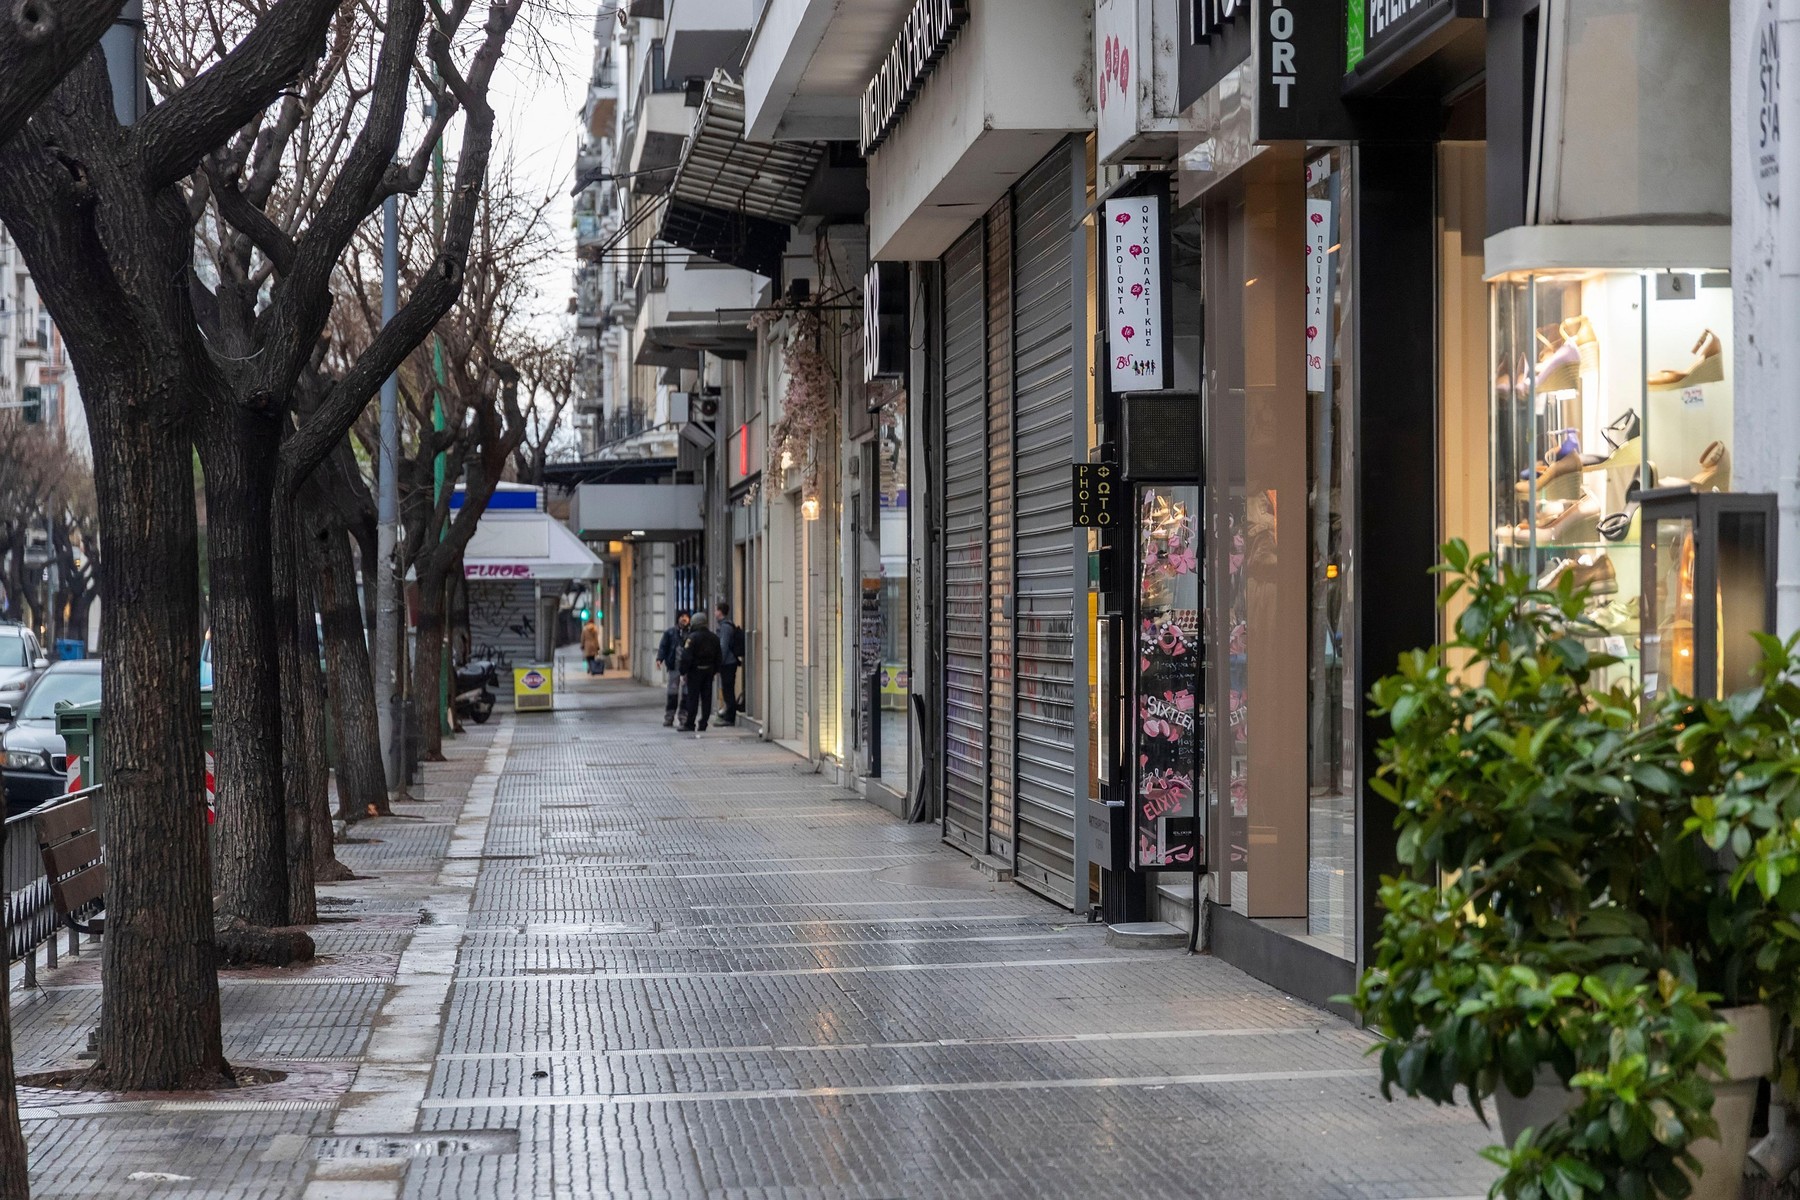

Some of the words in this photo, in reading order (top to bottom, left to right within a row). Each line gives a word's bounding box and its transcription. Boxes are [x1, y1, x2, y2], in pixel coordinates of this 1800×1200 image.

[860, 74, 880, 156] UNITED
[880, 31, 904, 130] COLORS
[903, 13, 913, 91] OF
[1270, 0, 1297, 108] ORT
[1116, 235, 1125, 315] ΠΡΟΪΟΝΤΑ
[1142, 206, 1152, 347] ΟΝΥΧΟΠΛΑΣΤΙΚΗΣ
[863, 262, 880, 384] BSB
[1079, 465, 1090, 525] PHOTO
[1097, 465, 1111, 526] ΦΩΤΟ
[1143, 786, 1186, 821] ELIXIR
